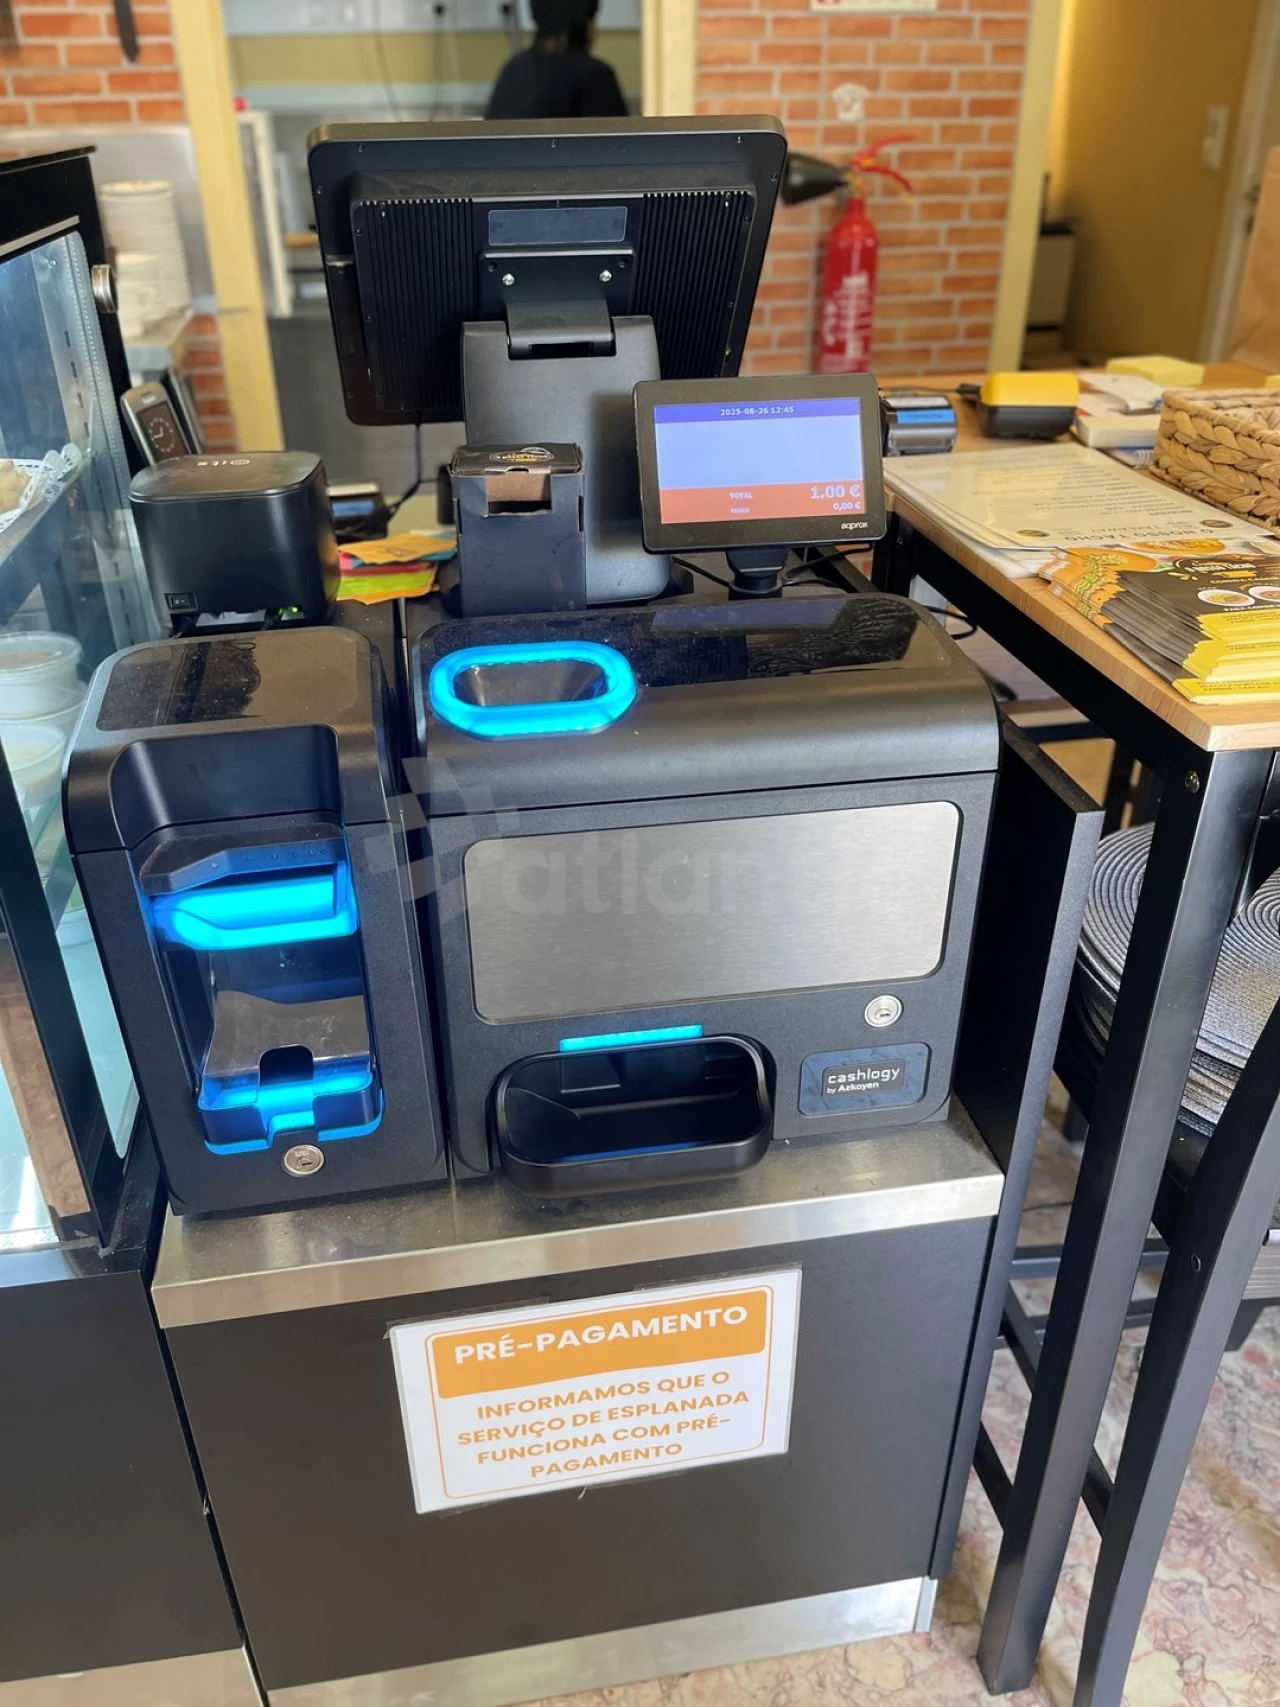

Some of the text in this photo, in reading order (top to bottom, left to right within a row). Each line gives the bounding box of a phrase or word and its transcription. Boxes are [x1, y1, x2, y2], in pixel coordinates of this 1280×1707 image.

[720, 405, 795, 416] 2025-08-26 12:45
[729, 484, 860, 500] TOTAL 1,00 €
[833, 502, 853, 511] 0,00
[854, 501, 862, 509] €
[826, 1081, 880, 1094] by Azkoyen
[827, 1067, 900, 1084] cashlogy
[455, 1305, 748, 1364] PRÉ-PAGAMENTO
[477, 1371, 730, 1419] INFORMAMOS QUE O
[457, 1391, 749, 1446] SERVIÇO DE ESPLANADA
[477, 1413, 732, 1465] FUNCIONA COM PRÉ-
[530, 1443, 682, 1478] PAGAMENTO
